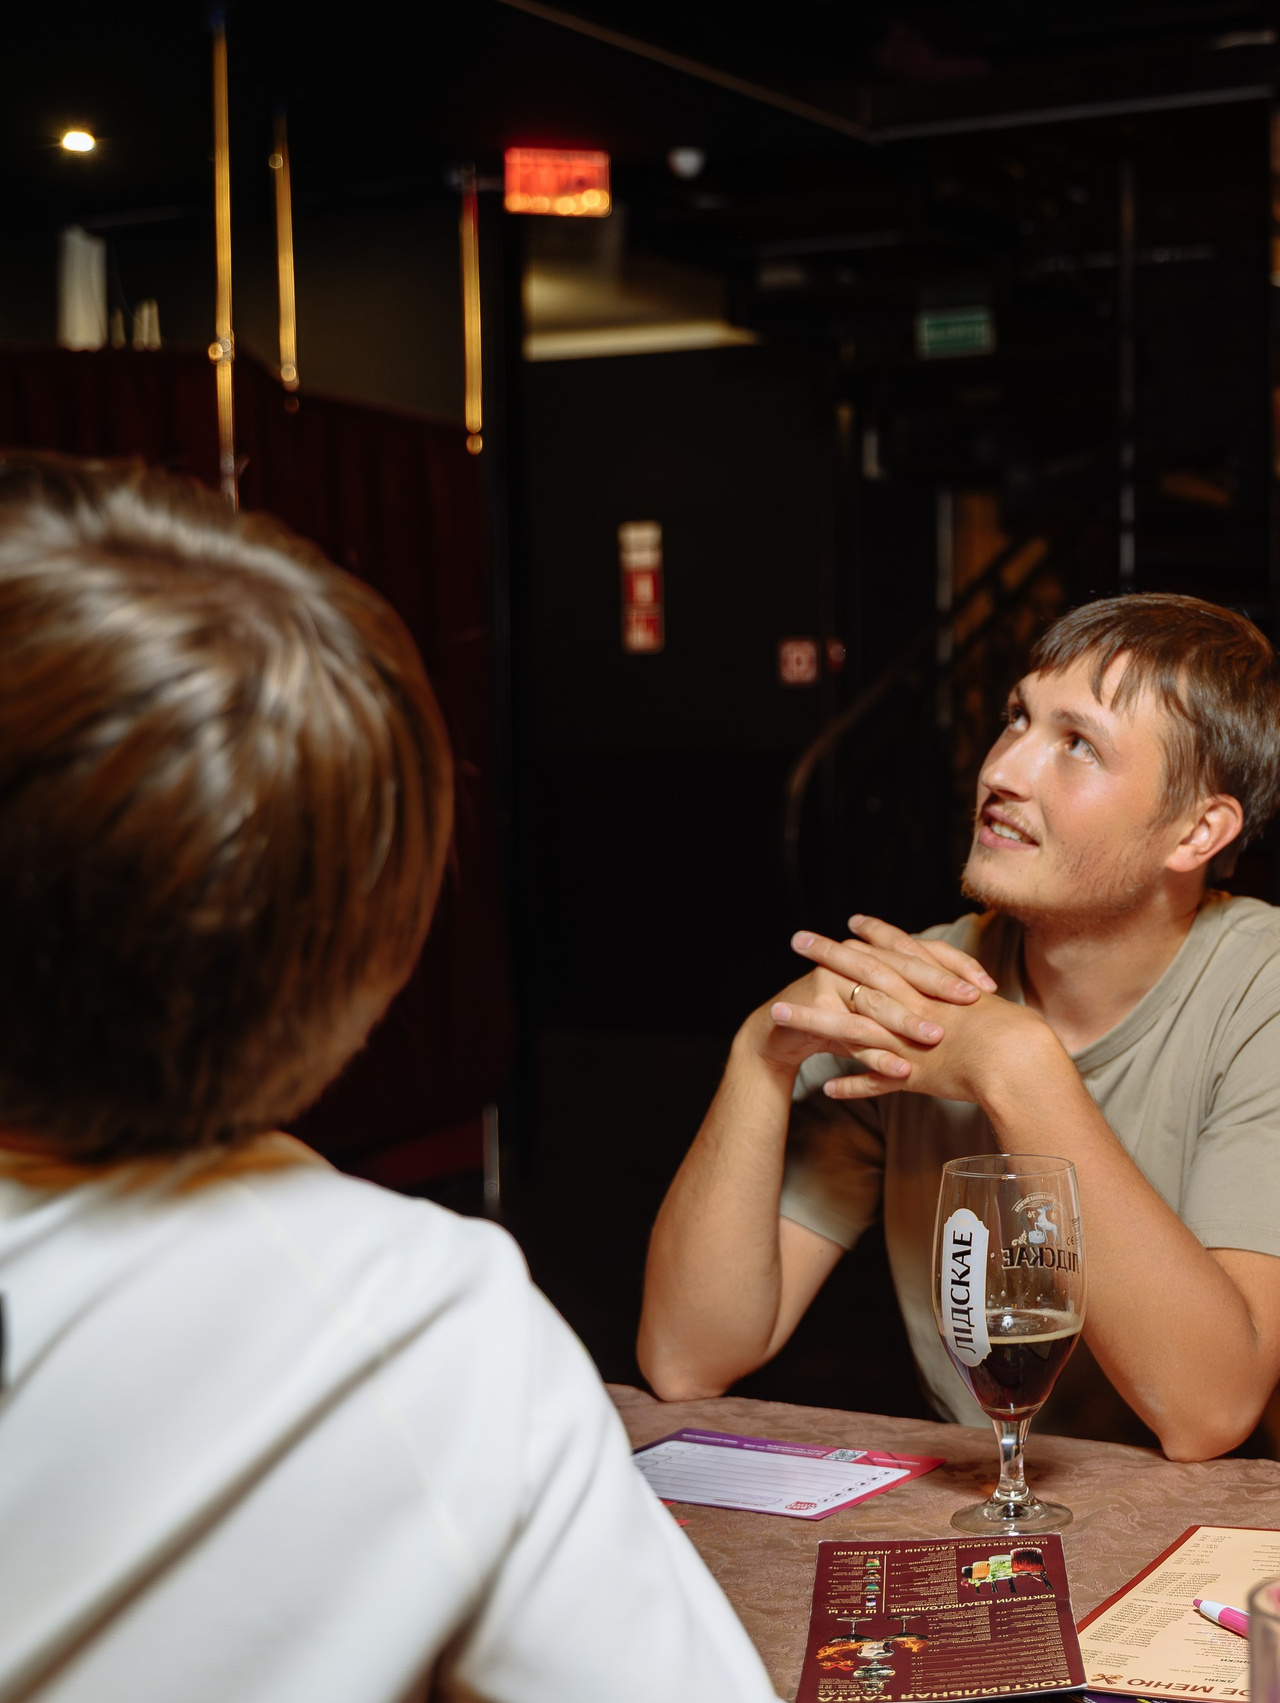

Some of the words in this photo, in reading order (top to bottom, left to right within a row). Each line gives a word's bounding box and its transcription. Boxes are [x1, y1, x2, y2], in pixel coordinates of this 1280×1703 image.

[950, 1230, 977, 1355] ЛІДСКАЕ
[996, 1594, 1056, 1604] КОКТЕЙЛИ
[890, 1601, 993, 1613] БЕЗАЛКОГОЛЬНЫЕ
[901, 1679, 1072, 1699] КОКТЕЙЛЬНАЯ
[1126, 1679, 1215, 1693] МЕНЮ
